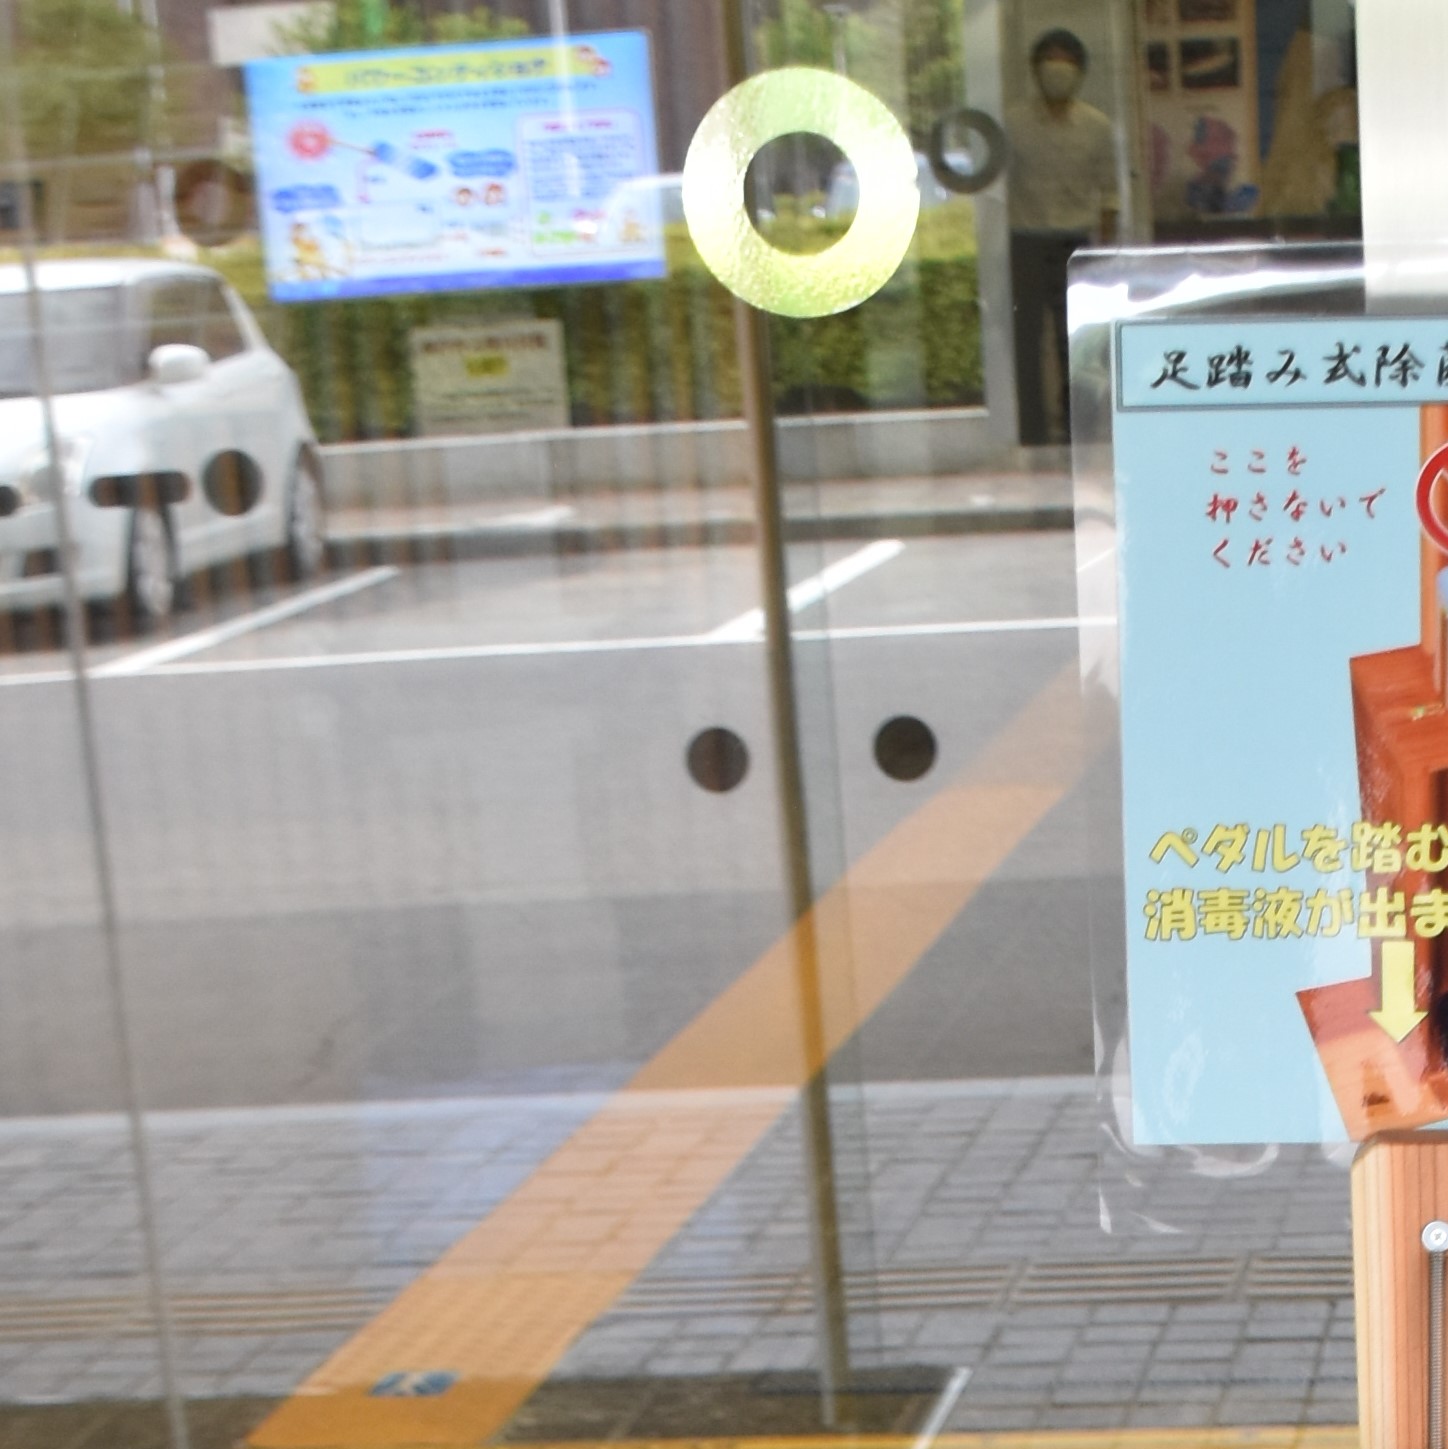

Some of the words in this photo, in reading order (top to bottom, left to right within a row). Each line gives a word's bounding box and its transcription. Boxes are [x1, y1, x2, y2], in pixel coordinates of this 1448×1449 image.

[1209, 444, 1310, 476] ここを
[1204, 488, 1387, 522] 押さないで
[1211, 538, 1348, 568] ください
